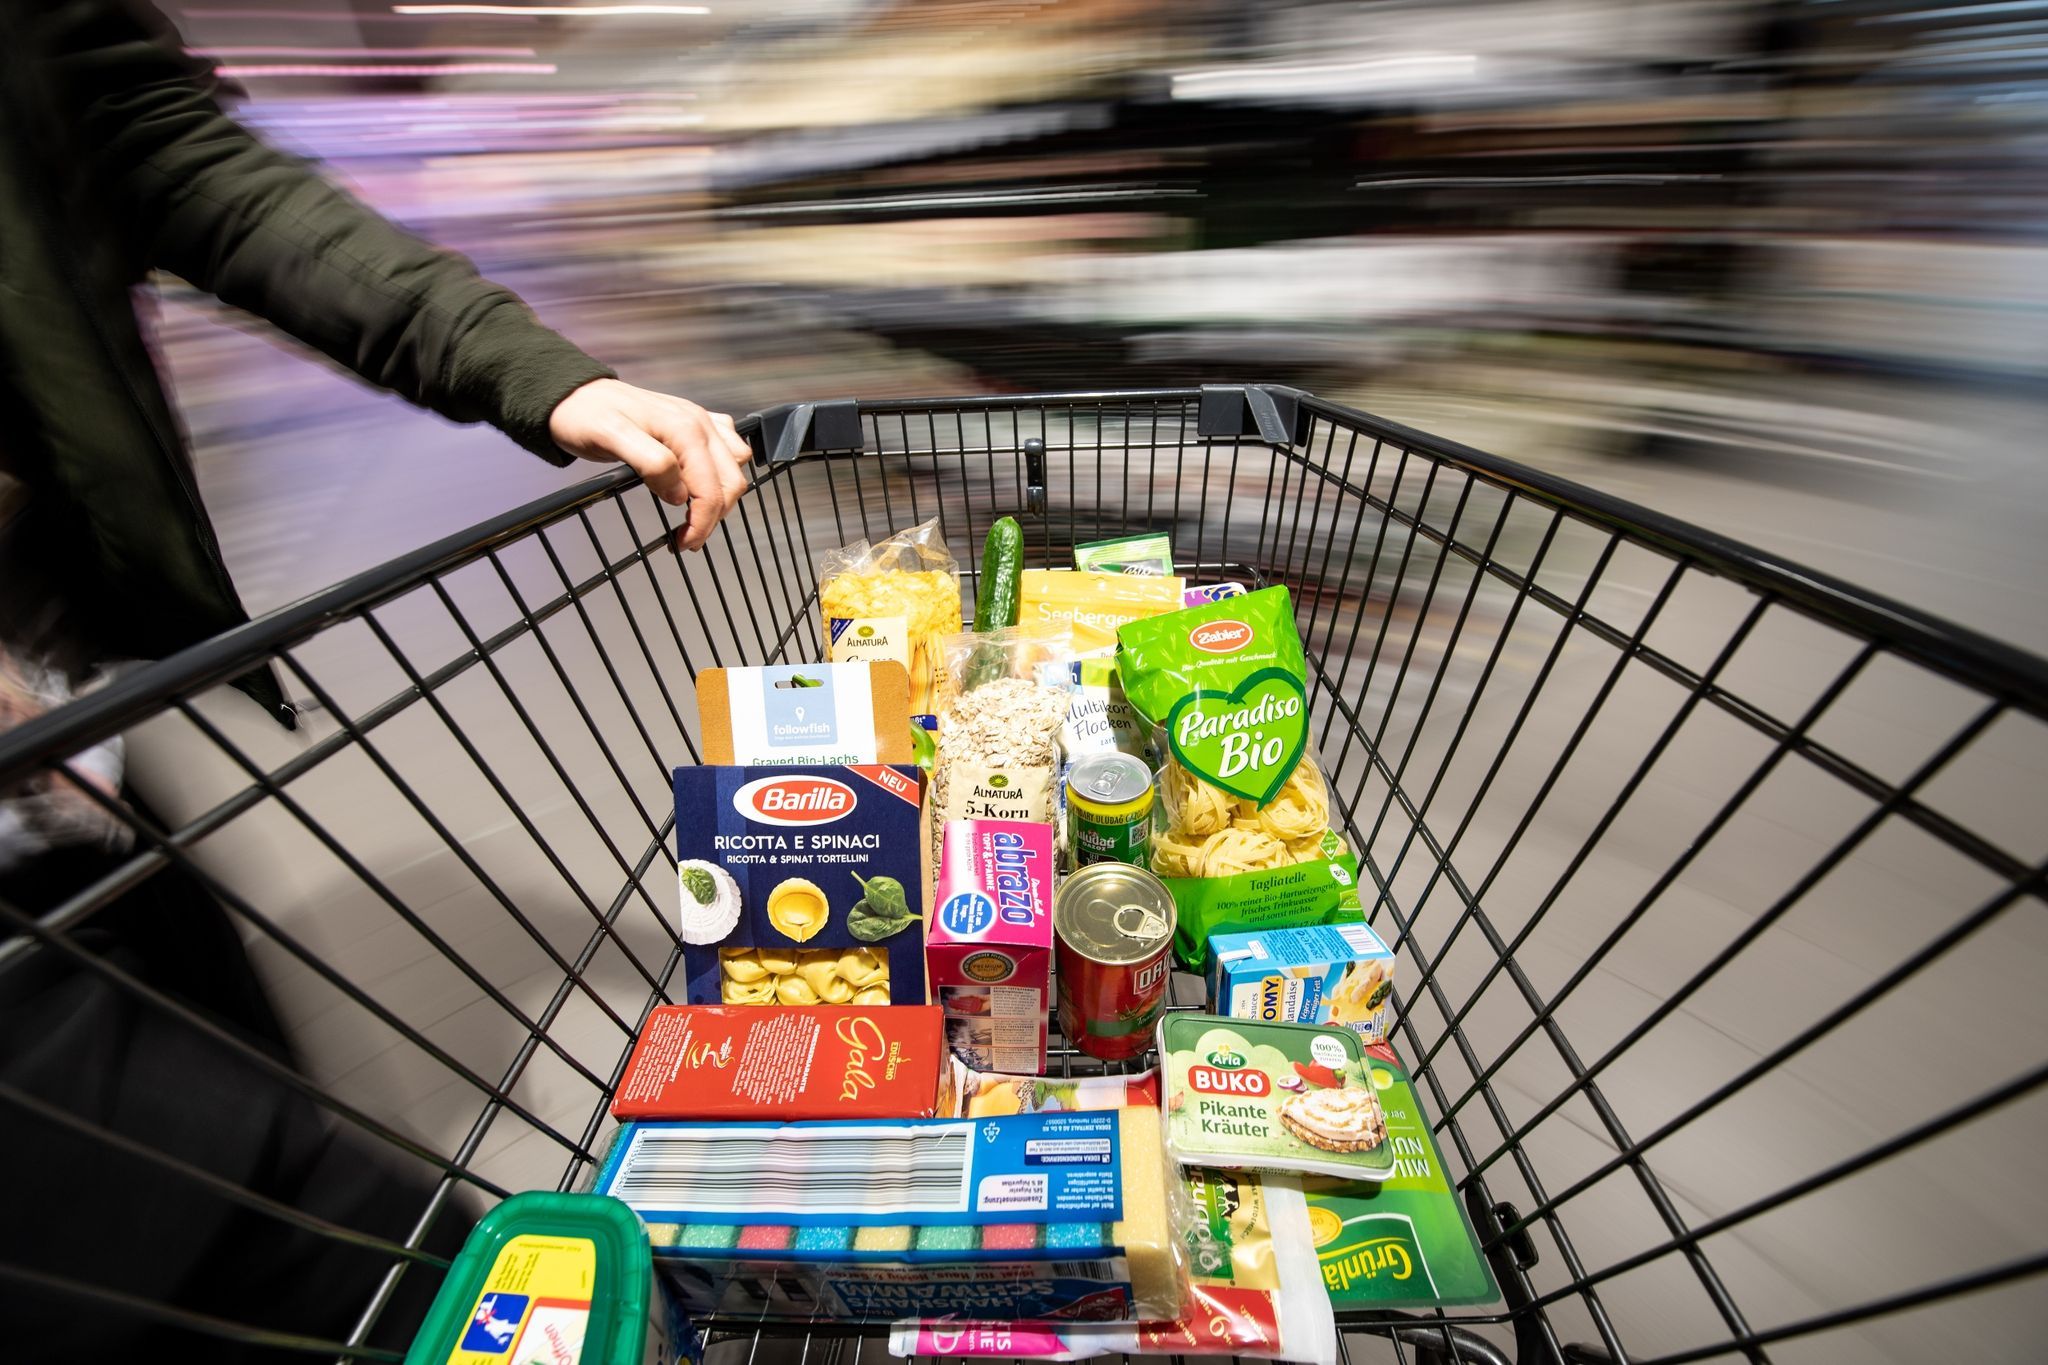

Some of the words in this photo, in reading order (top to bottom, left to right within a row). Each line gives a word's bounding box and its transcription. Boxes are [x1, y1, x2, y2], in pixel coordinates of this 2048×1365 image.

[1038, 603, 1137, 628] Seeberger
[847, 636, 888, 648] ALNATURA
[773, 722, 831, 736] followfish
[1073, 716, 1132, 741] Flocken
[1178, 692, 1300, 748] Paradiso
[1217, 731, 1284, 779] Bio
[877, 770, 908, 794] NEU
[973, 785, 1023, 800] ALNATURA
[761, 787, 847, 811] Barilla
[965, 800, 1030, 820] 5-Korn
[714, 835, 788, 850] RICOTTA
[794, 835, 805, 850] E
[811, 834, 880, 850] SPINACI
[982, 832, 992, 851] TOPF
[726, 855, 767, 864] RICOTTA
[769, 855, 777, 864] &
[780, 854, 813, 864] SPINAT
[816, 854, 869, 864] TORTELLINI
[982, 851, 993, 859] &
[985, 859, 995, 892] PFANNE
[993, 832, 1037, 925] abrazo
[1249, 871, 1307, 891] Tagliatelle
[1239, 897, 1262, 908] reiner
[1241, 901, 1271, 918] frisches
[1273, 895, 1318, 909] Trinkwasser
[1249, 915, 1265, 924] und
[1265, 911, 1288, 921] sonst
[1288, 905, 1314, 916] nichts.
[1250, 993, 1259, 1020] Sauces
[835, 1016, 886, 1101] Gala
[885, 1041, 899, 1081] EDUSCHO
[1211, 1053, 1241, 1066] Arla
[1195, 1070, 1263, 1094] BUKO
[1199, 1100, 1267, 1120] Pikante
[1201, 1119, 1270, 1138] Kräuter
[1321, 1243, 1412, 1291] Grünlä
[1208, 1315, 1232, 1339] 6
